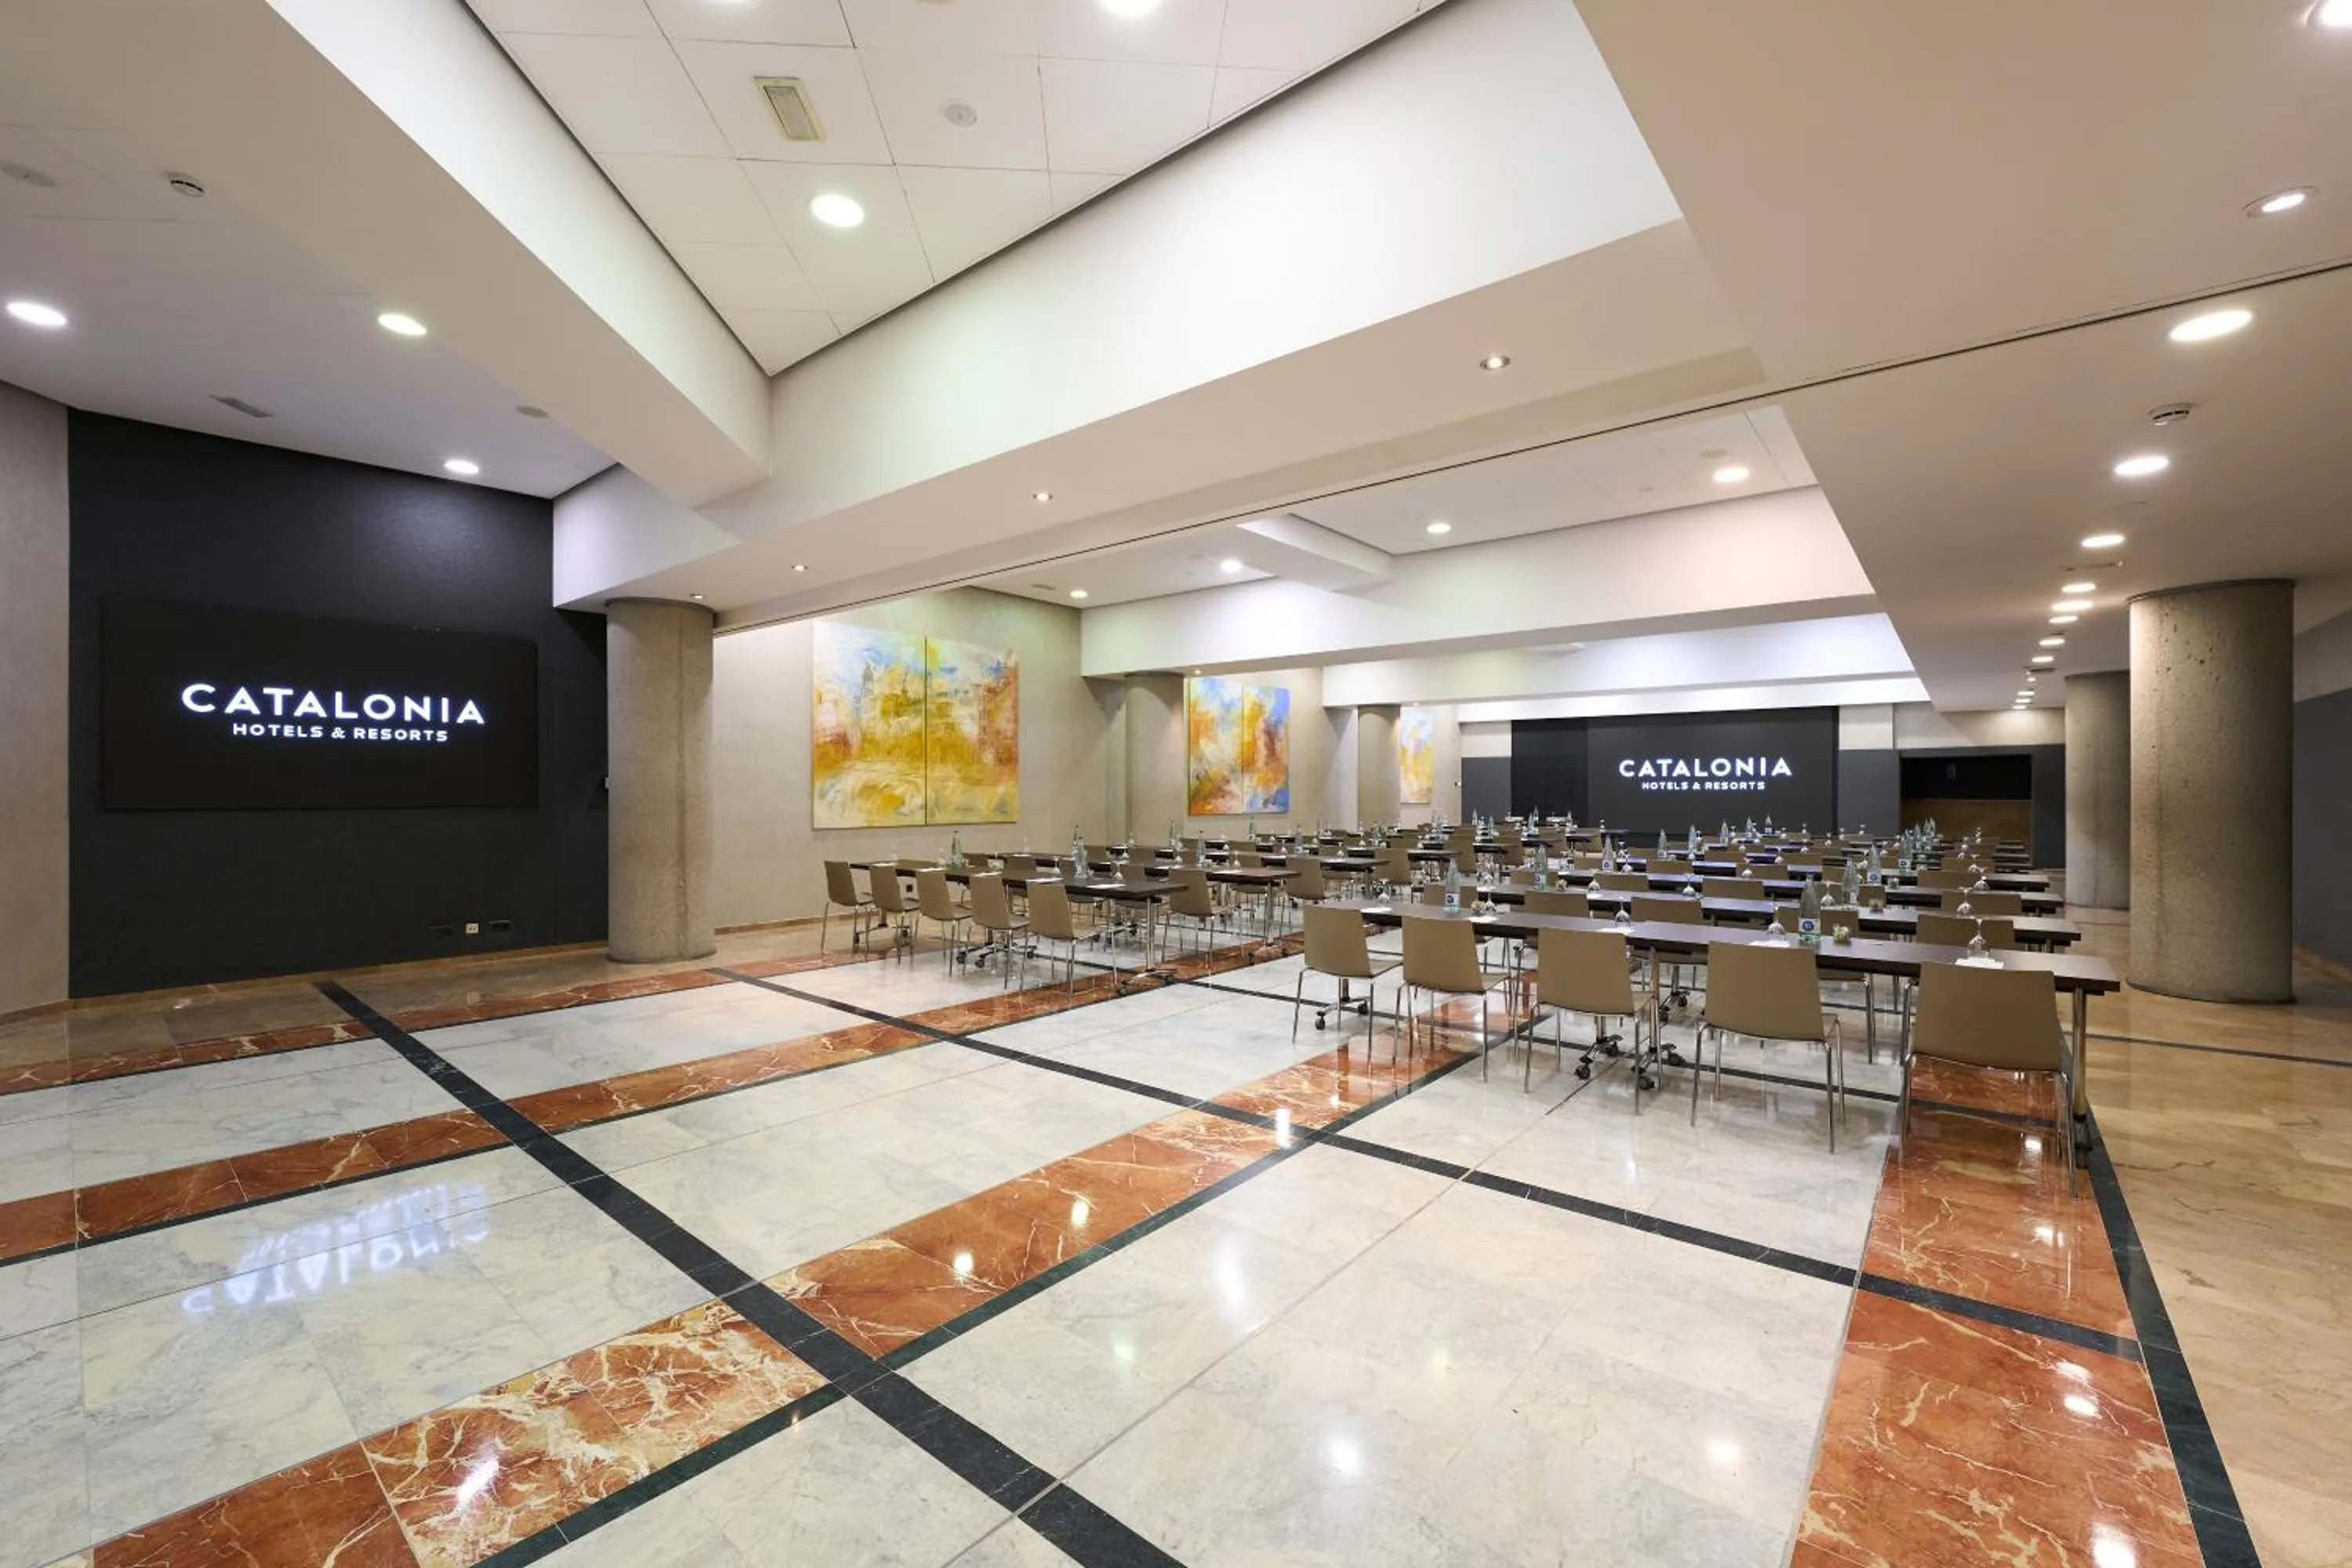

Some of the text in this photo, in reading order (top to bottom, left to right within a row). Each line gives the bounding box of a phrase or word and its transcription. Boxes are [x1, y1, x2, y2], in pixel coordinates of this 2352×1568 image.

[181, 683, 485, 724] CATALONIA
[233, 722, 448, 742] HOTELS & RESORTS
[1618, 756, 1793, 778] CATALONIA
[1641, 781, 1766, 790] HOTELS & RESORTS
